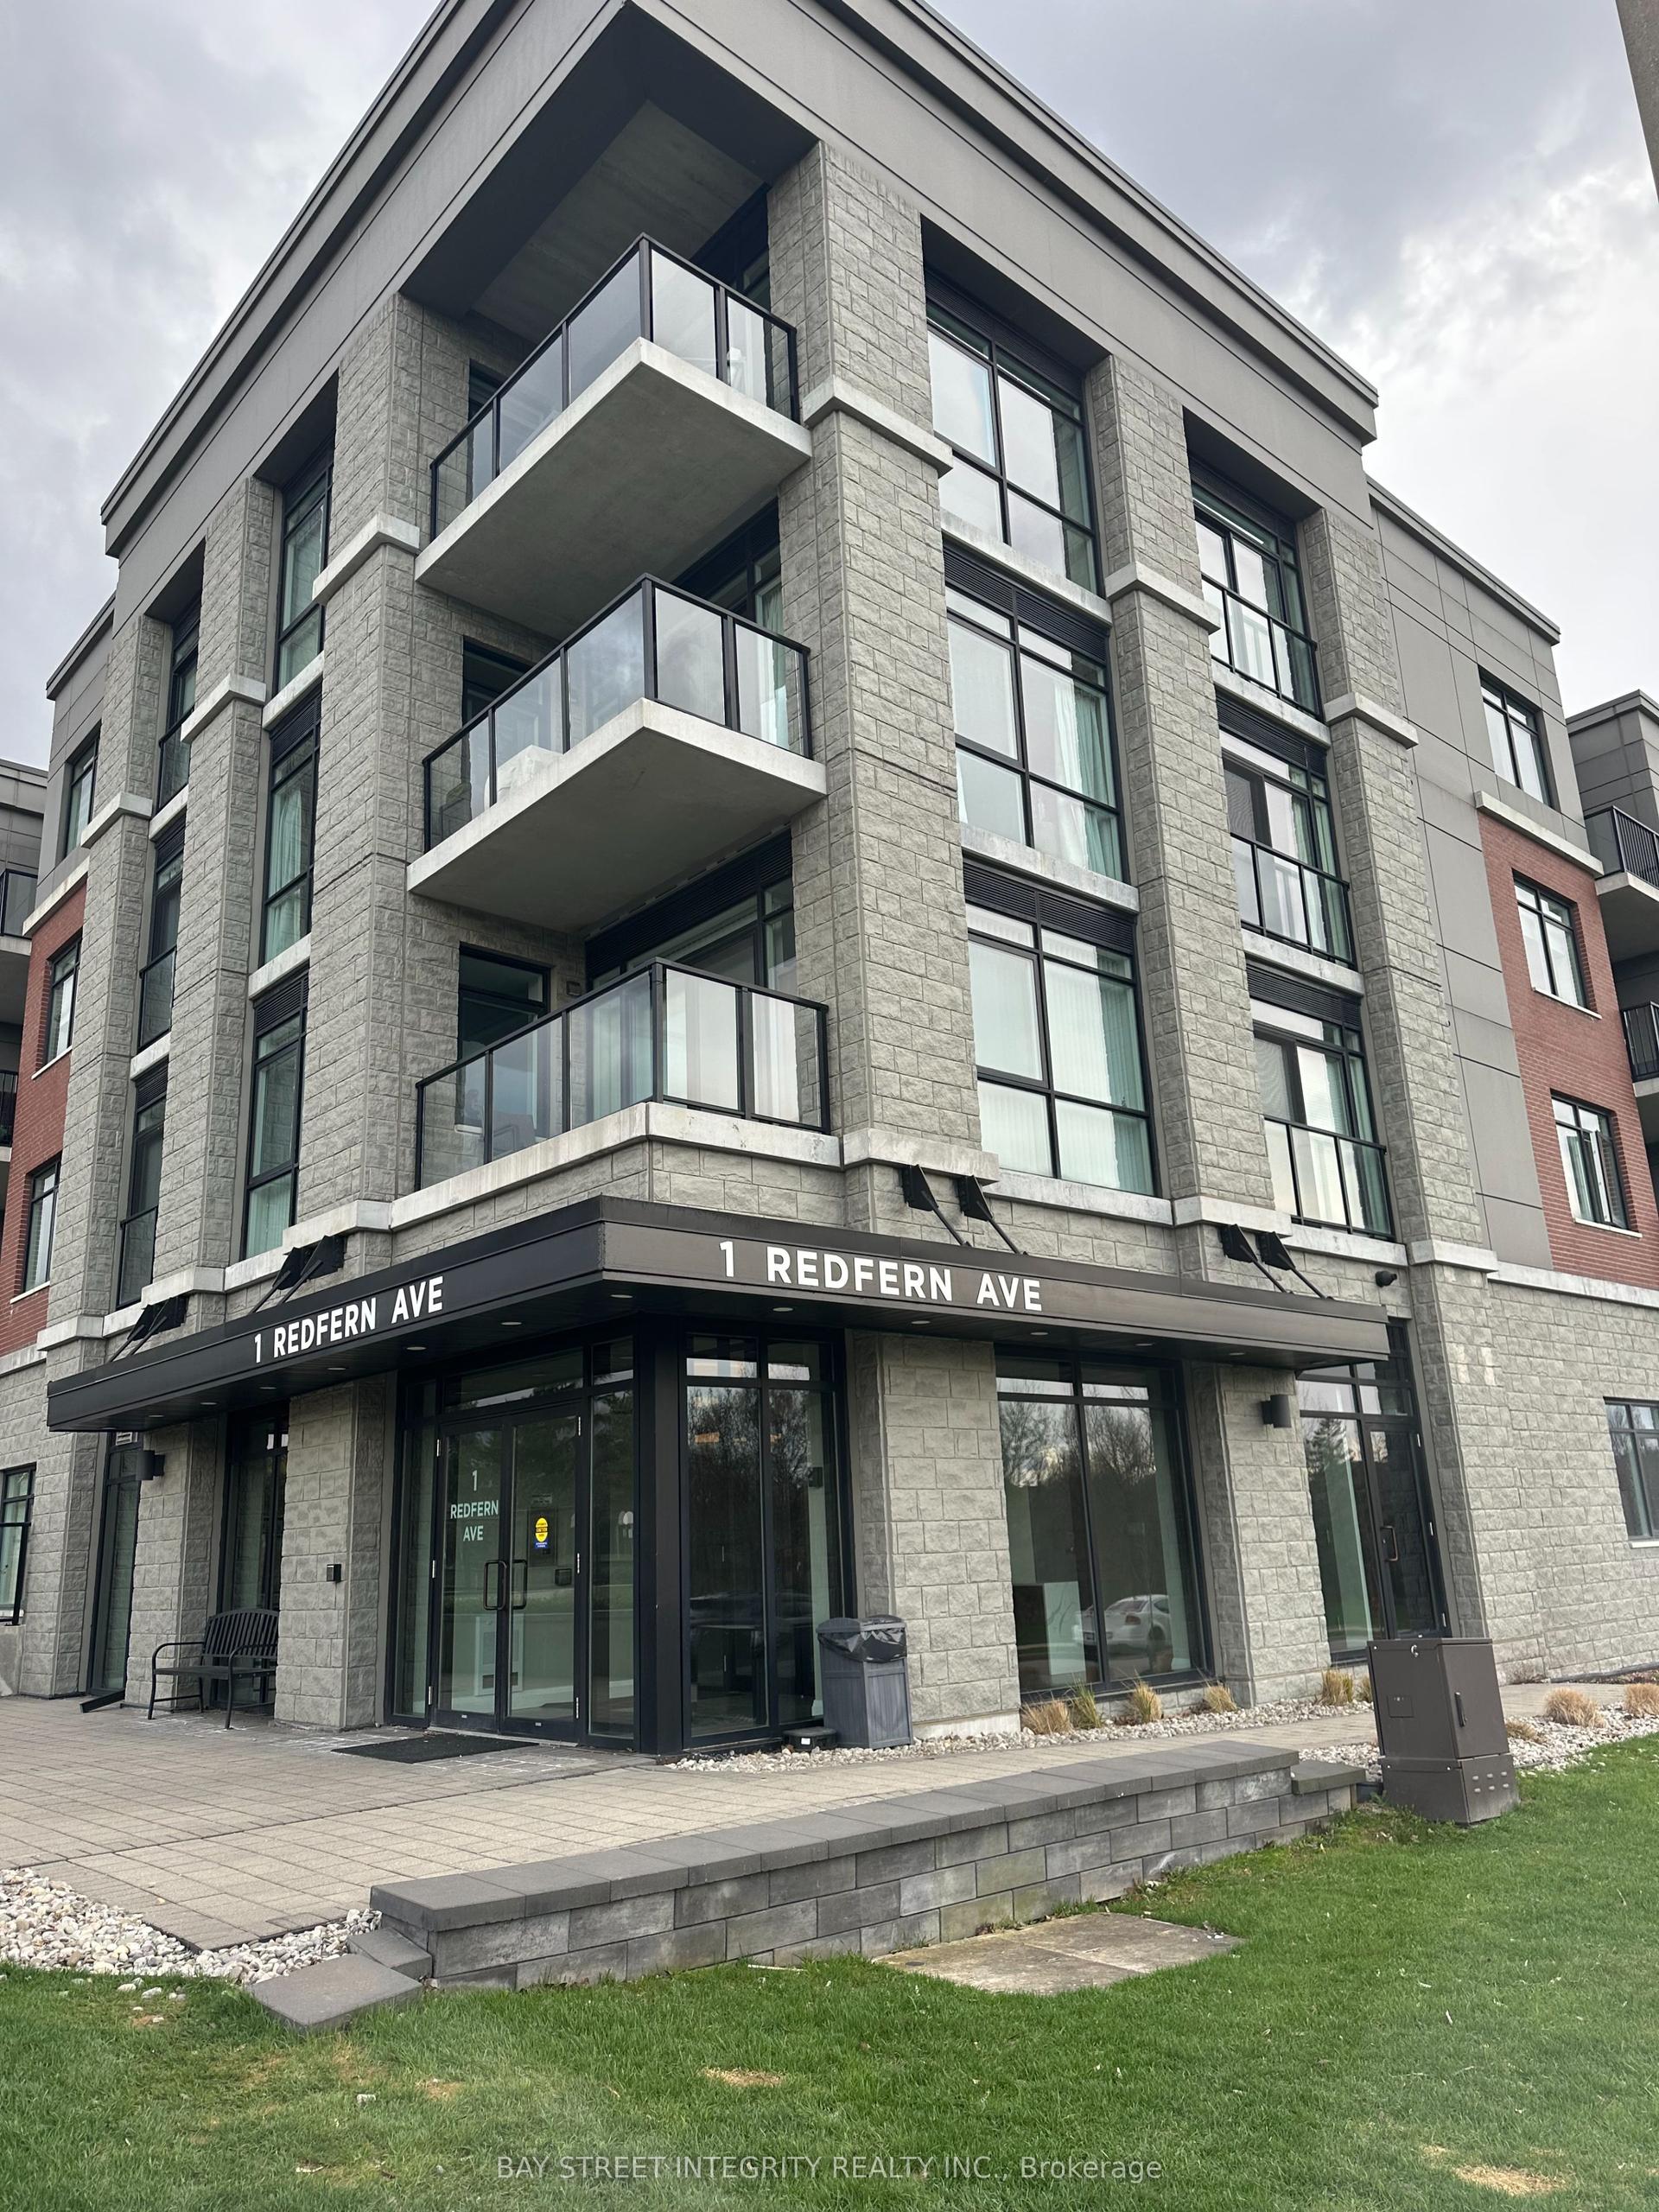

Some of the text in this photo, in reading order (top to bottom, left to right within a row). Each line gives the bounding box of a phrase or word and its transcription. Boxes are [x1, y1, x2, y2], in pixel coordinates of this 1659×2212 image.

[719, 1242, 1042, 1312] 1 REDFERN AVE
[254, 1275, 443, 1363] 1 REDFERN AVE
[472, 1470, 478, 1491] 1
[450, 1499, 499, 1519] REDFERN
[462, 1525, 484, 1541] AVE
